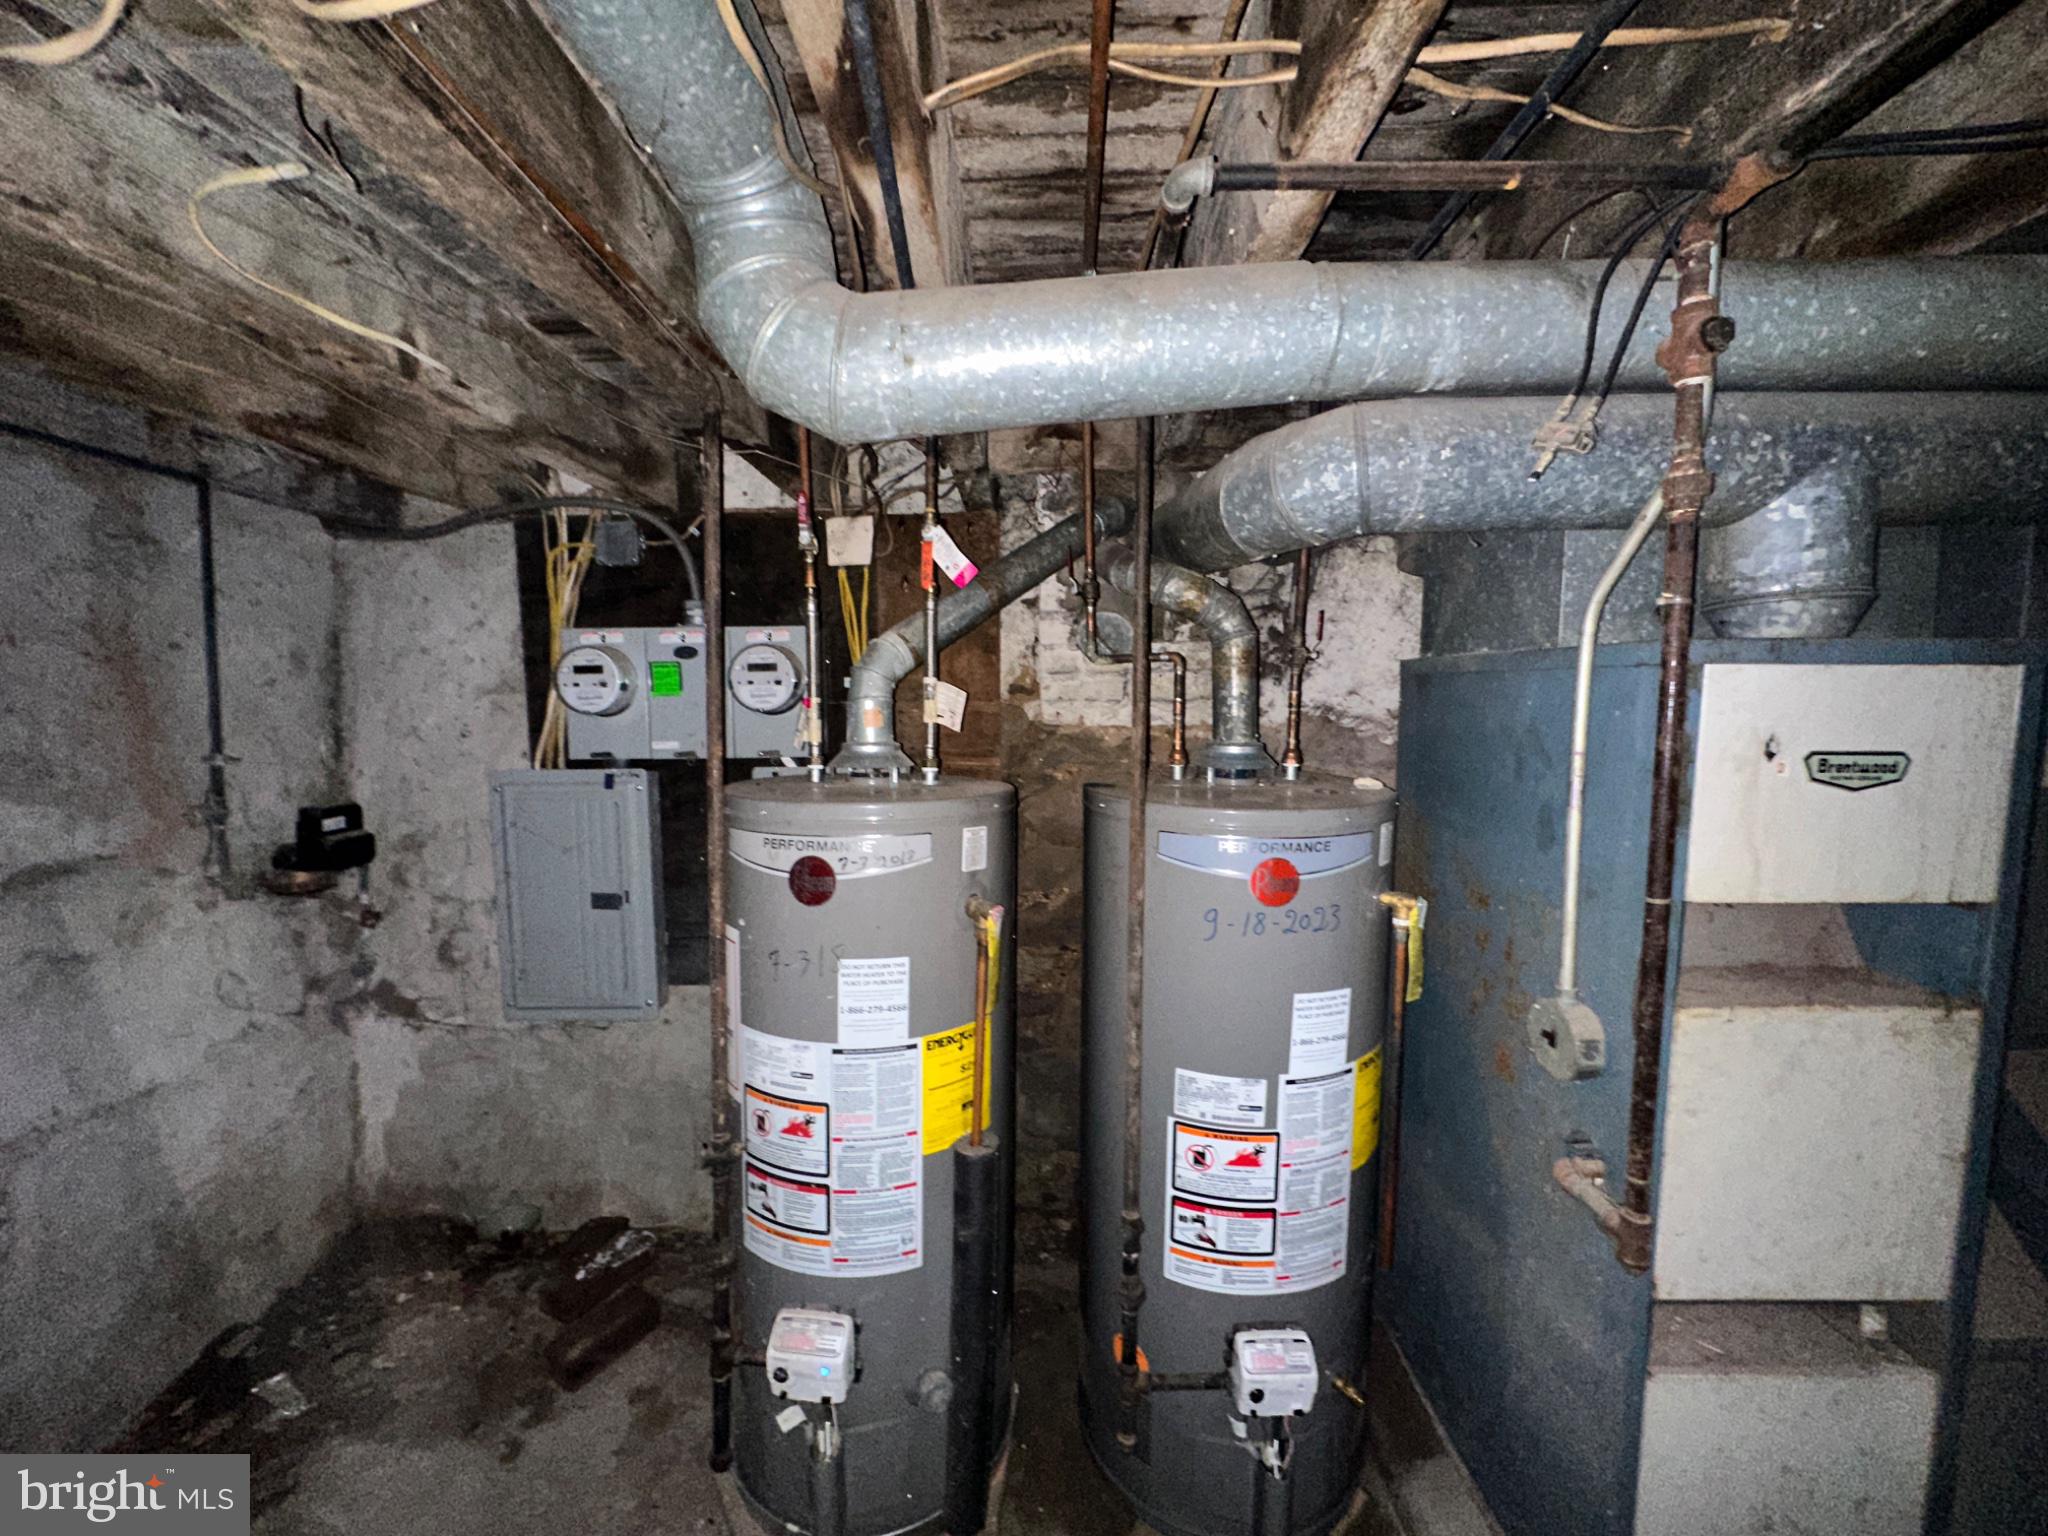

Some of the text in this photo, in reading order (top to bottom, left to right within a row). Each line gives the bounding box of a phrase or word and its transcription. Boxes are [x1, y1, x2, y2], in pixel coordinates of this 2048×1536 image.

[1817, 758, 1899, 773] Brentwood
[1218, 841, 1332, 853] PERFORMANCE
[1203, 904, 1342, 941] 9-18-2023
